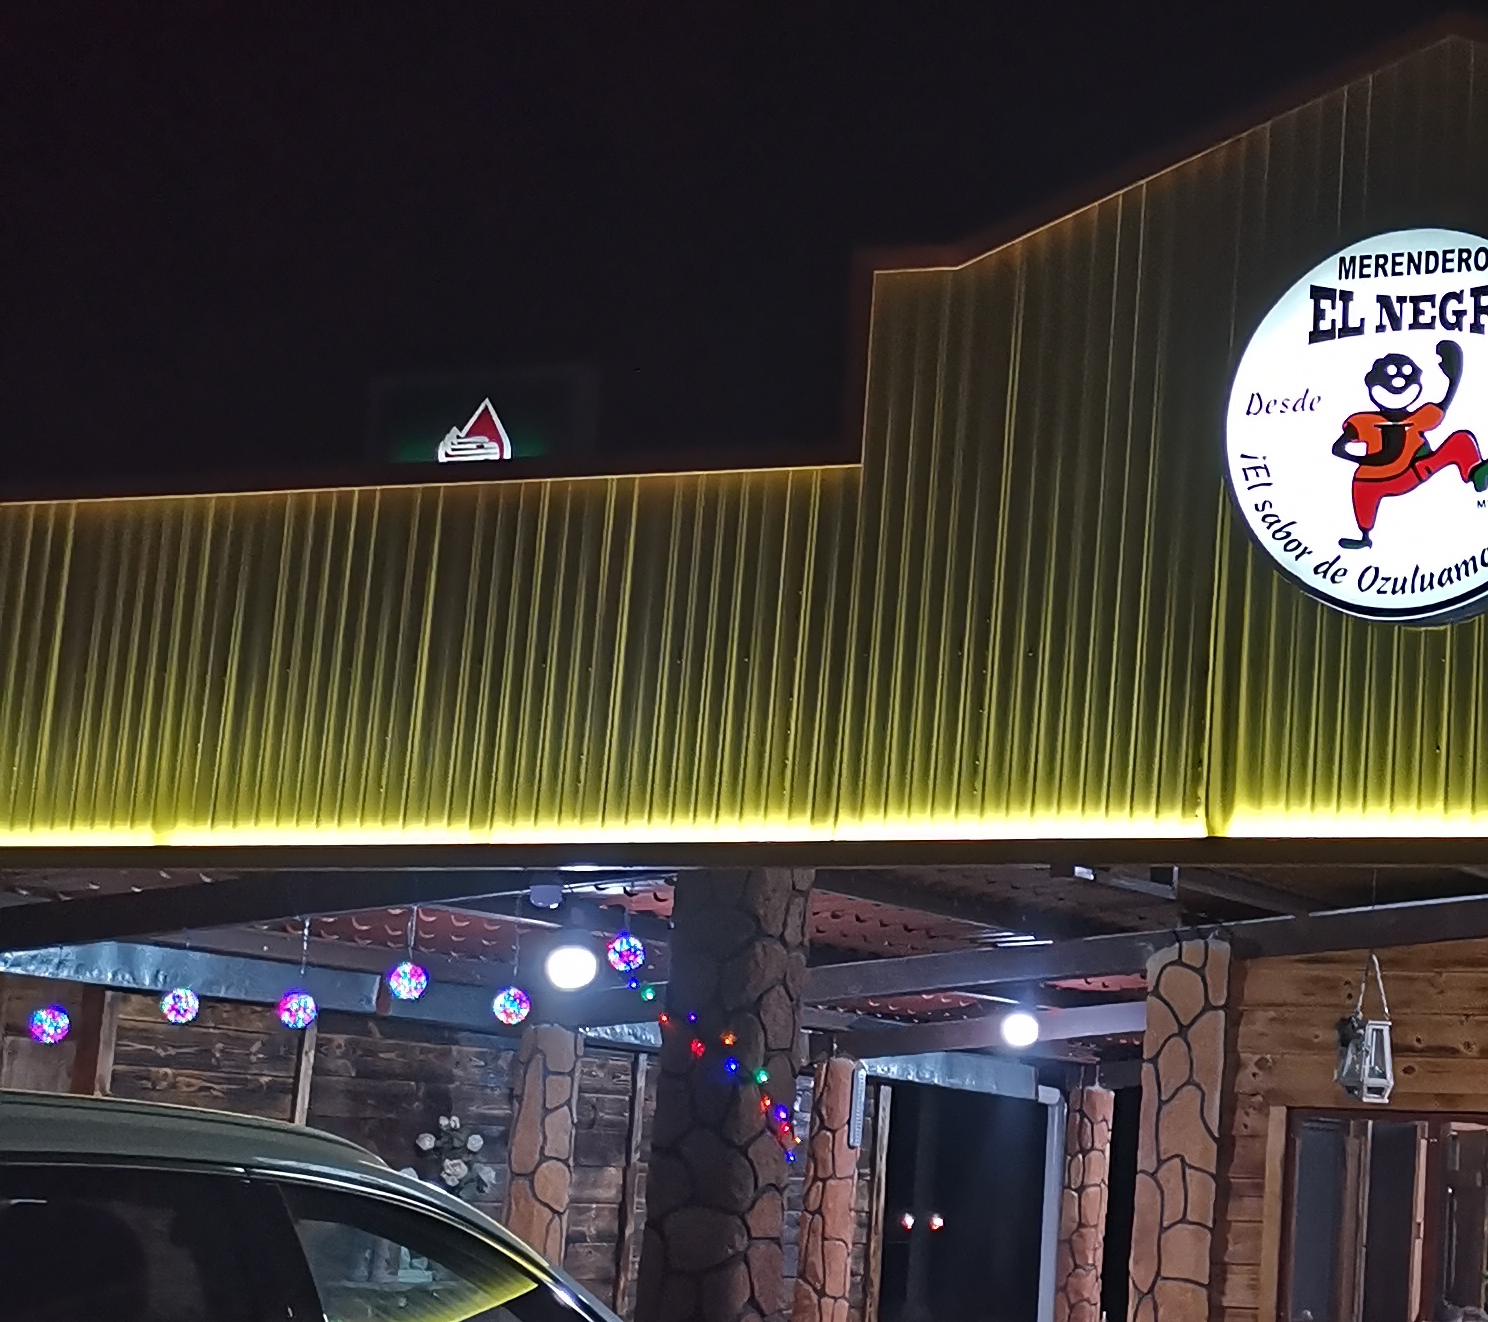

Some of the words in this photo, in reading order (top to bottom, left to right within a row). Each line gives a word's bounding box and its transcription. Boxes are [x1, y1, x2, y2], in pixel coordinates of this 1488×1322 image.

[1307, 283, 1366, 345] EL
[1245, 387, 1322, 416] Desde
[1254, 499, 1314, 562] sabor
[1313, 554, 1348, 585] de
